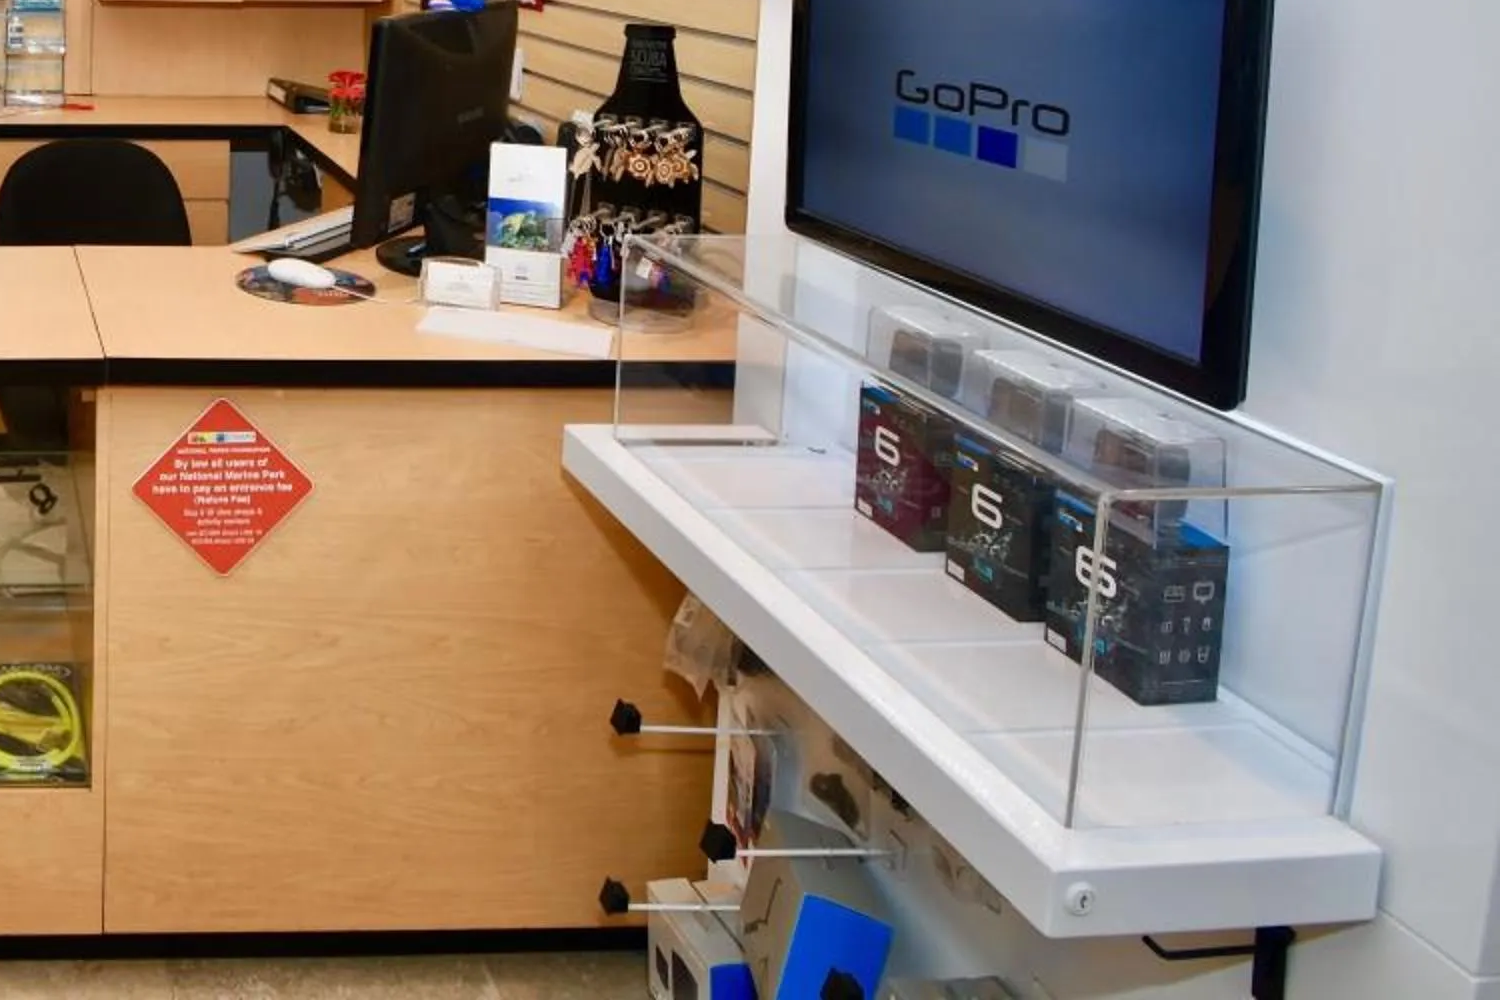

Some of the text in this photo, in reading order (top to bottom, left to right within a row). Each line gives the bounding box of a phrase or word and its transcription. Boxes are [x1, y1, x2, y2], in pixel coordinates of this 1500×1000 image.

[896, 69, 1070, 136] GoPro
[875, 425, 900, 467] 6
[971, 483, 1004, 529] 6
[1075, 545, 1117, 598] 6
